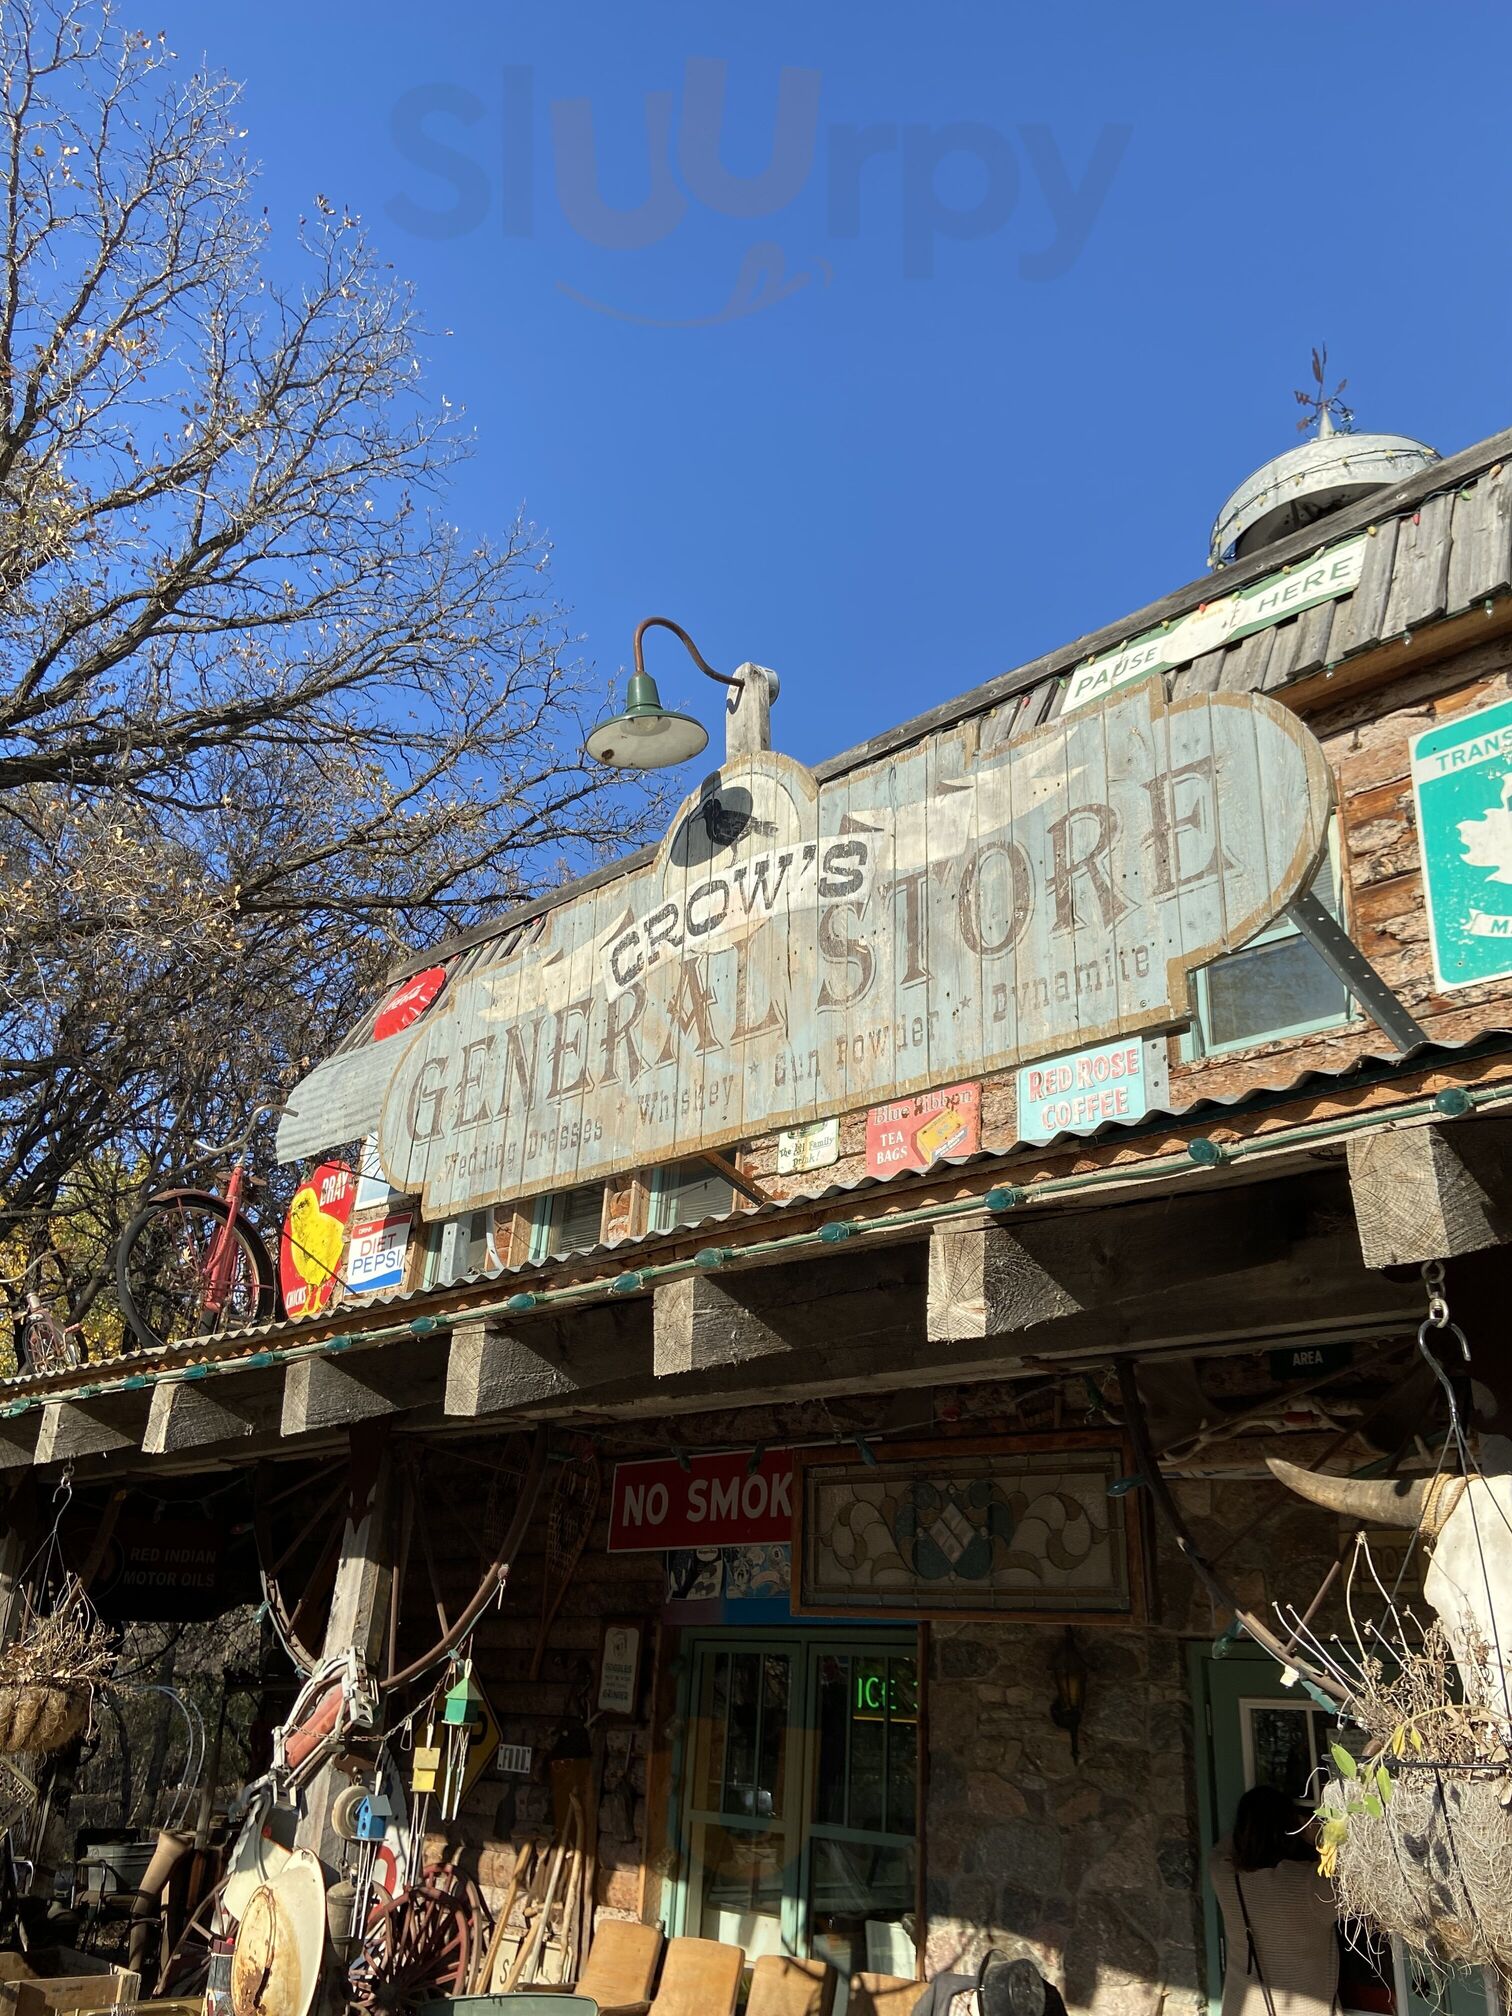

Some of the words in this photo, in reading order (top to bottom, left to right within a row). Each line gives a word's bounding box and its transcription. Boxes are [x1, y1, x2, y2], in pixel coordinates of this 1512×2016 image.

[1074, 646, 1158, 698] PAUSE
[1257, 556, 1353, 614] HERE
[611, 840, 868, 987] CROW'S
[406, 919, 785, 1148] GENERAL
[815, 755, 1239, 1014] STORE
[444, 1136, 517, 1182] Wedding
[527, 1118, 604, 1161] Dresses
[637, 1074, 734, 1126] Whiskey
[773, 1047, 822, 1088] Gun
[835, 1009, 940, 1071] Powder
[990, 943, 1151, 1024] Dynamite
[1028, 1064, 1073, 1103] RED
[1075, 1048, 1139, 1091] ROSE
[873, 1104, 910, 1126] Blue
[1041, 1086, 1129, 1131] COFFEE
[879, 1130, 904, 1147] TEA
[876, 1145, 908, 1166] BAGS
[320, 1170, 349, 1207] BRAY
[360, 1232, 397, 1257] DIET
[351, 1249, 401, 1276] PEPSI
[1292, 1349, 1324, 1367] AREA
[622, 1483, 669, 1527] NO
[686, 1471, 793, 1523] SMOK
[130, 1546, 160, 1562] RED
[164, 1548, 216, 1564] INDIAN
[123, 1569, 178, 1586] MOTOR
[181, 1571, 216, 1588] OILS
